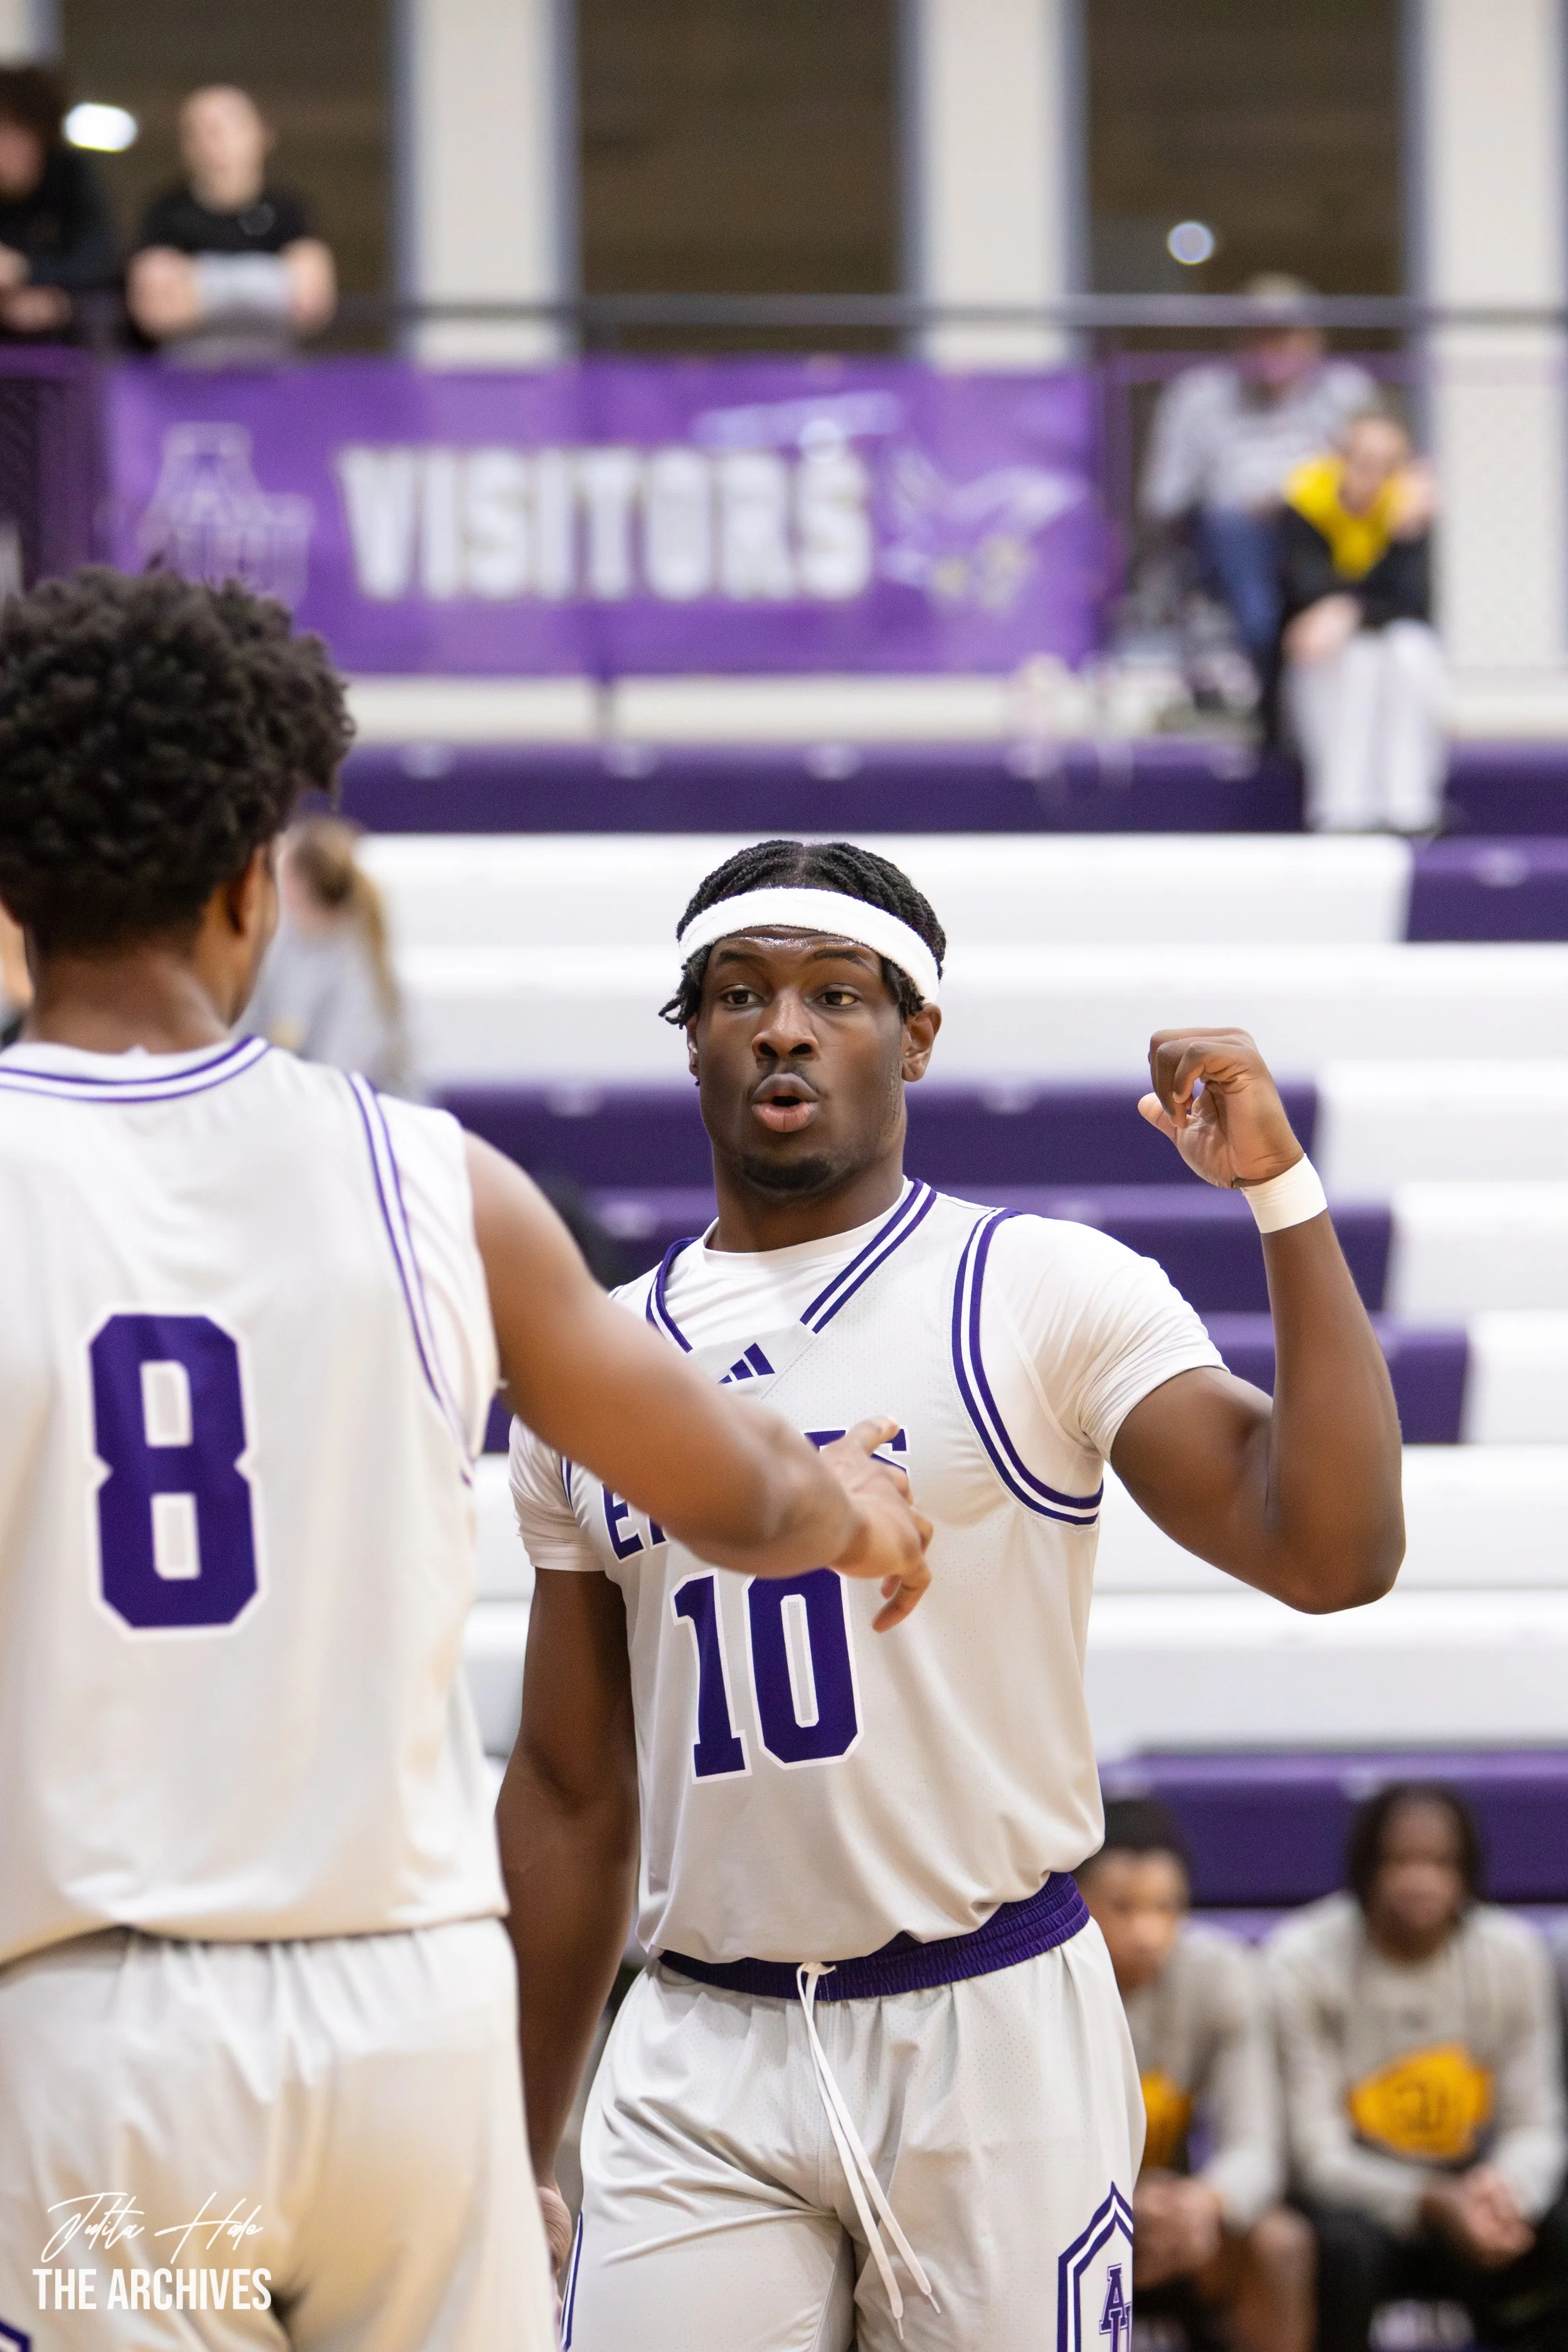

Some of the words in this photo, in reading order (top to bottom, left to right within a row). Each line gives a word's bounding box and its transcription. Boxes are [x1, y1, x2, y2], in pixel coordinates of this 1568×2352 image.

[339, 444, 871, 599] VISITORS
[88, 1313, 260, 1630] 8
[672, 1565, 862, 1779] 10
